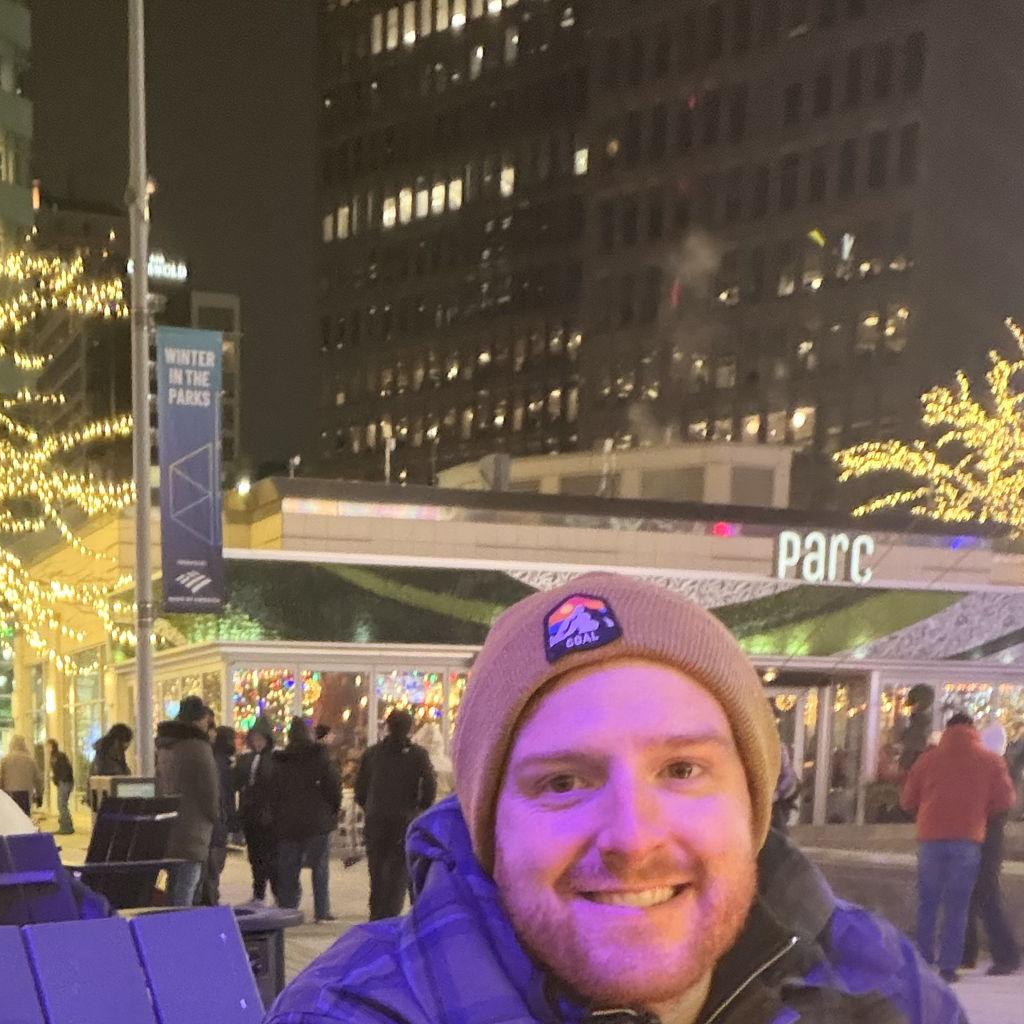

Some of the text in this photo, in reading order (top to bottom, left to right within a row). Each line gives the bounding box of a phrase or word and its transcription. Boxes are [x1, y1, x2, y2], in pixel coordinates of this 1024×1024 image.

[164, 347, 215, 367] WINTER
[168, 367, 210, 387] IN THE
[168, 387, 211, 406] PARKS
